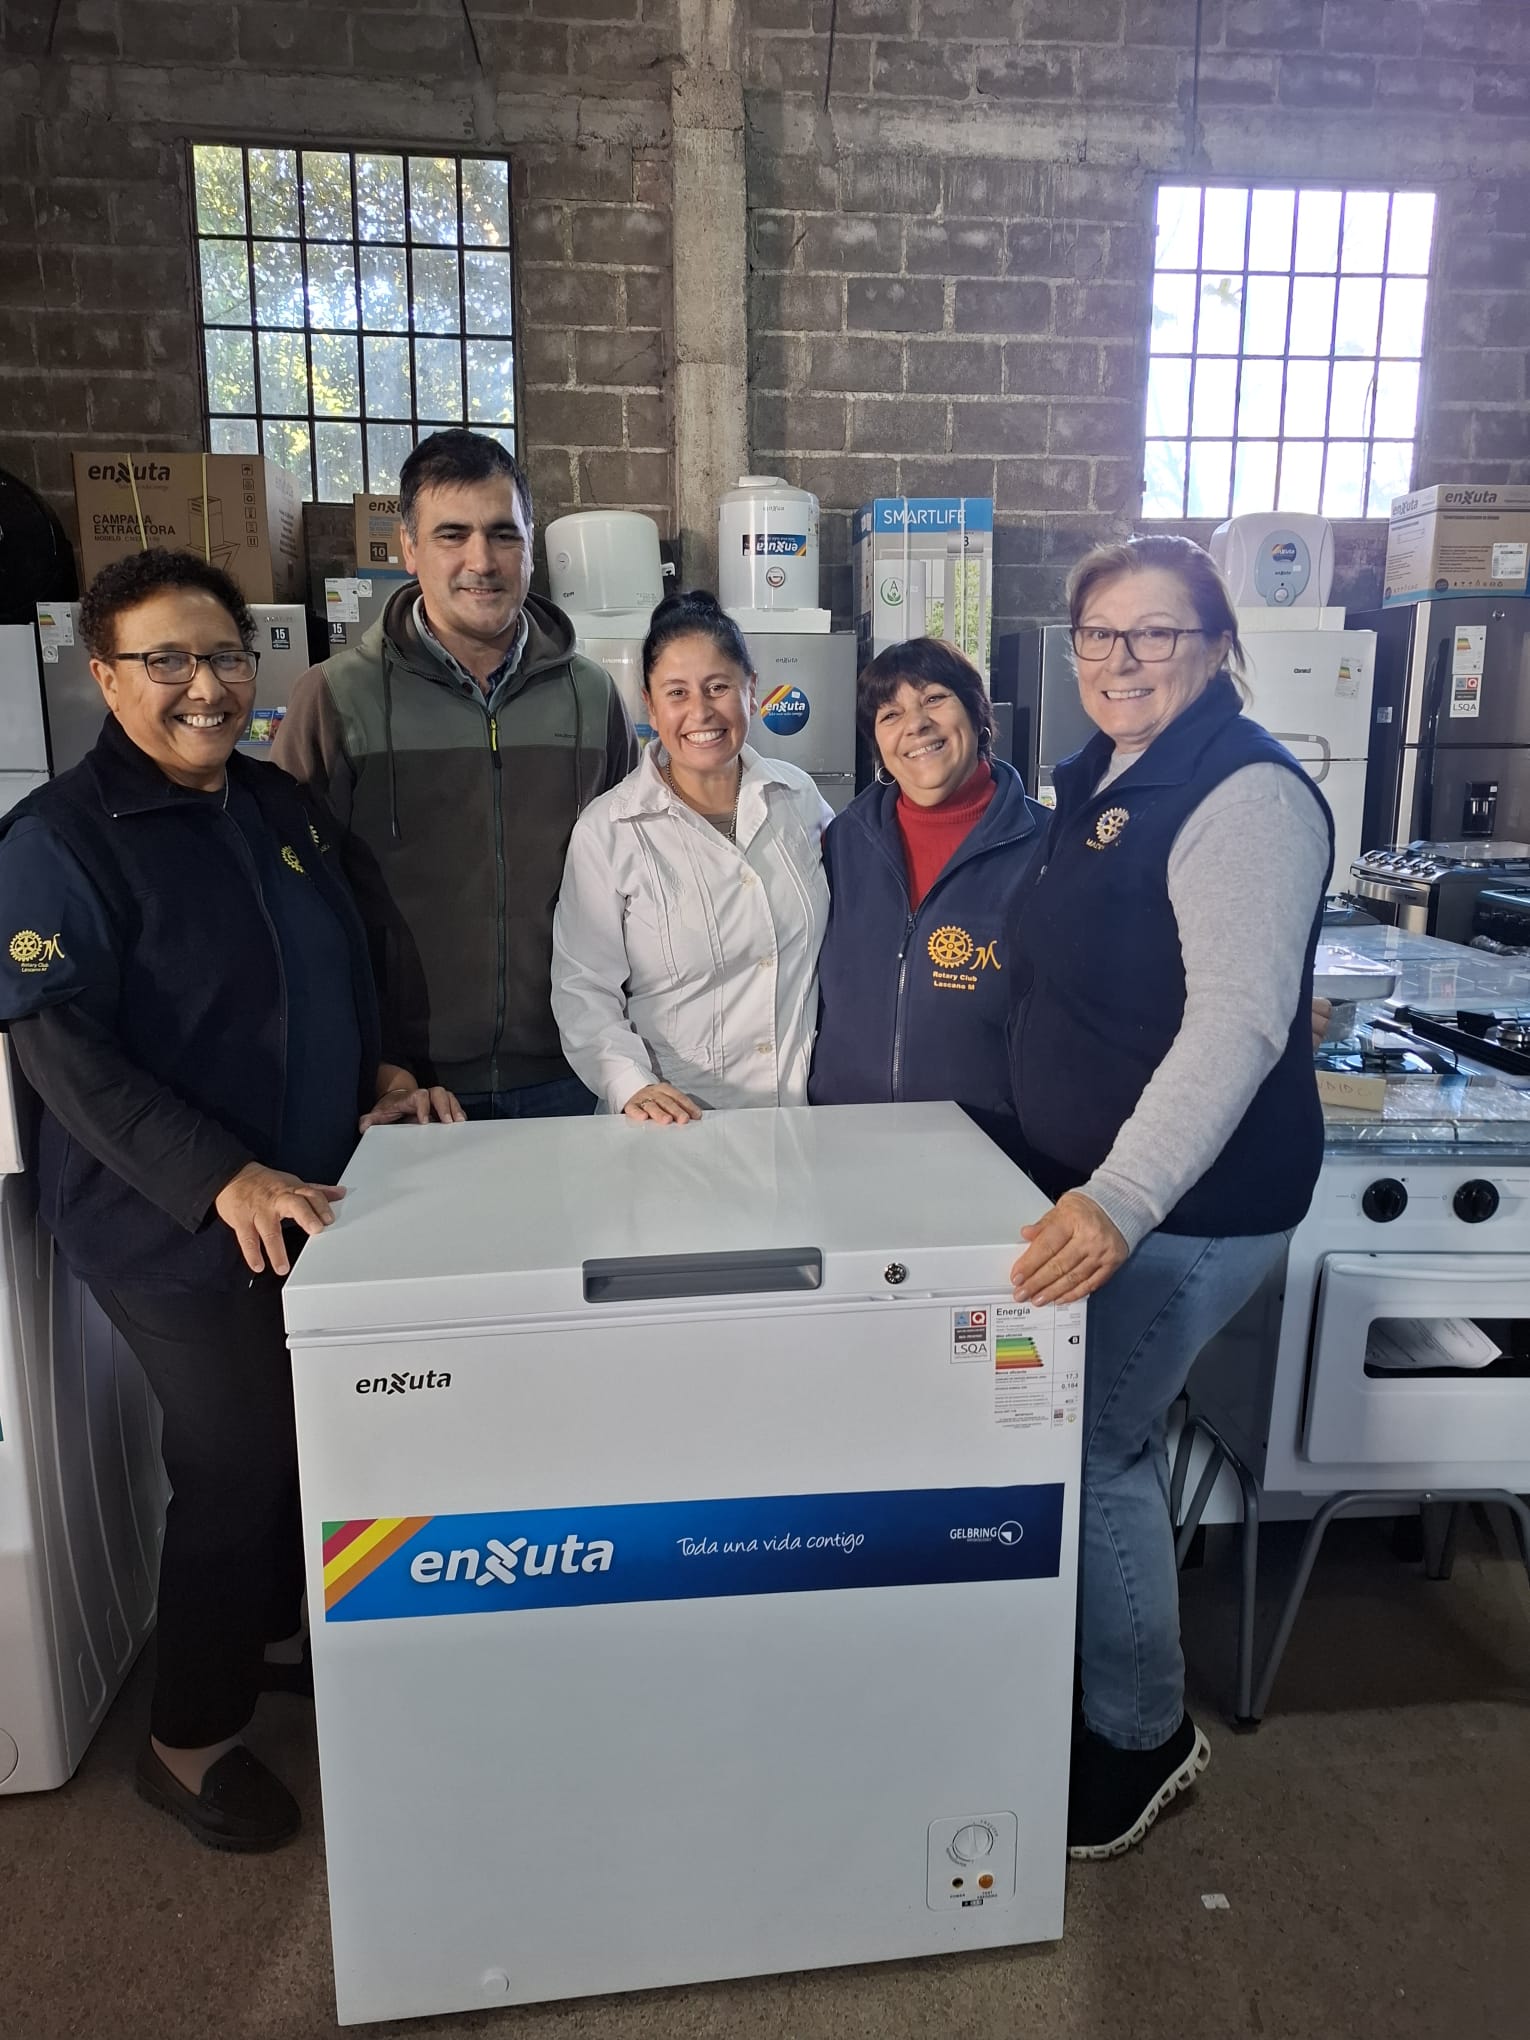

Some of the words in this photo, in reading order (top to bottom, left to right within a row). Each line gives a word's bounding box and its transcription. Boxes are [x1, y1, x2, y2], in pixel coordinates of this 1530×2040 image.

[883, 509, 968, 525] SMARTLIFE
[372, 547, 386, 557] 10
[275, 628, 286, 639] 15
[332, 623, 343, 634] 15
[932, 971, 958, 981] Rotary
[959, 974, 978, 982] Club
[954, 1343, 987, 1355] LSQA
[949, 1526, 997, 1540] GELBRING
[676, 1536, 719, 1556] Toda
[723, 1539, 758, 1553] una
[763, 1533, 802, 1551] vida
[806, 1531, 865, 1554] contigo
